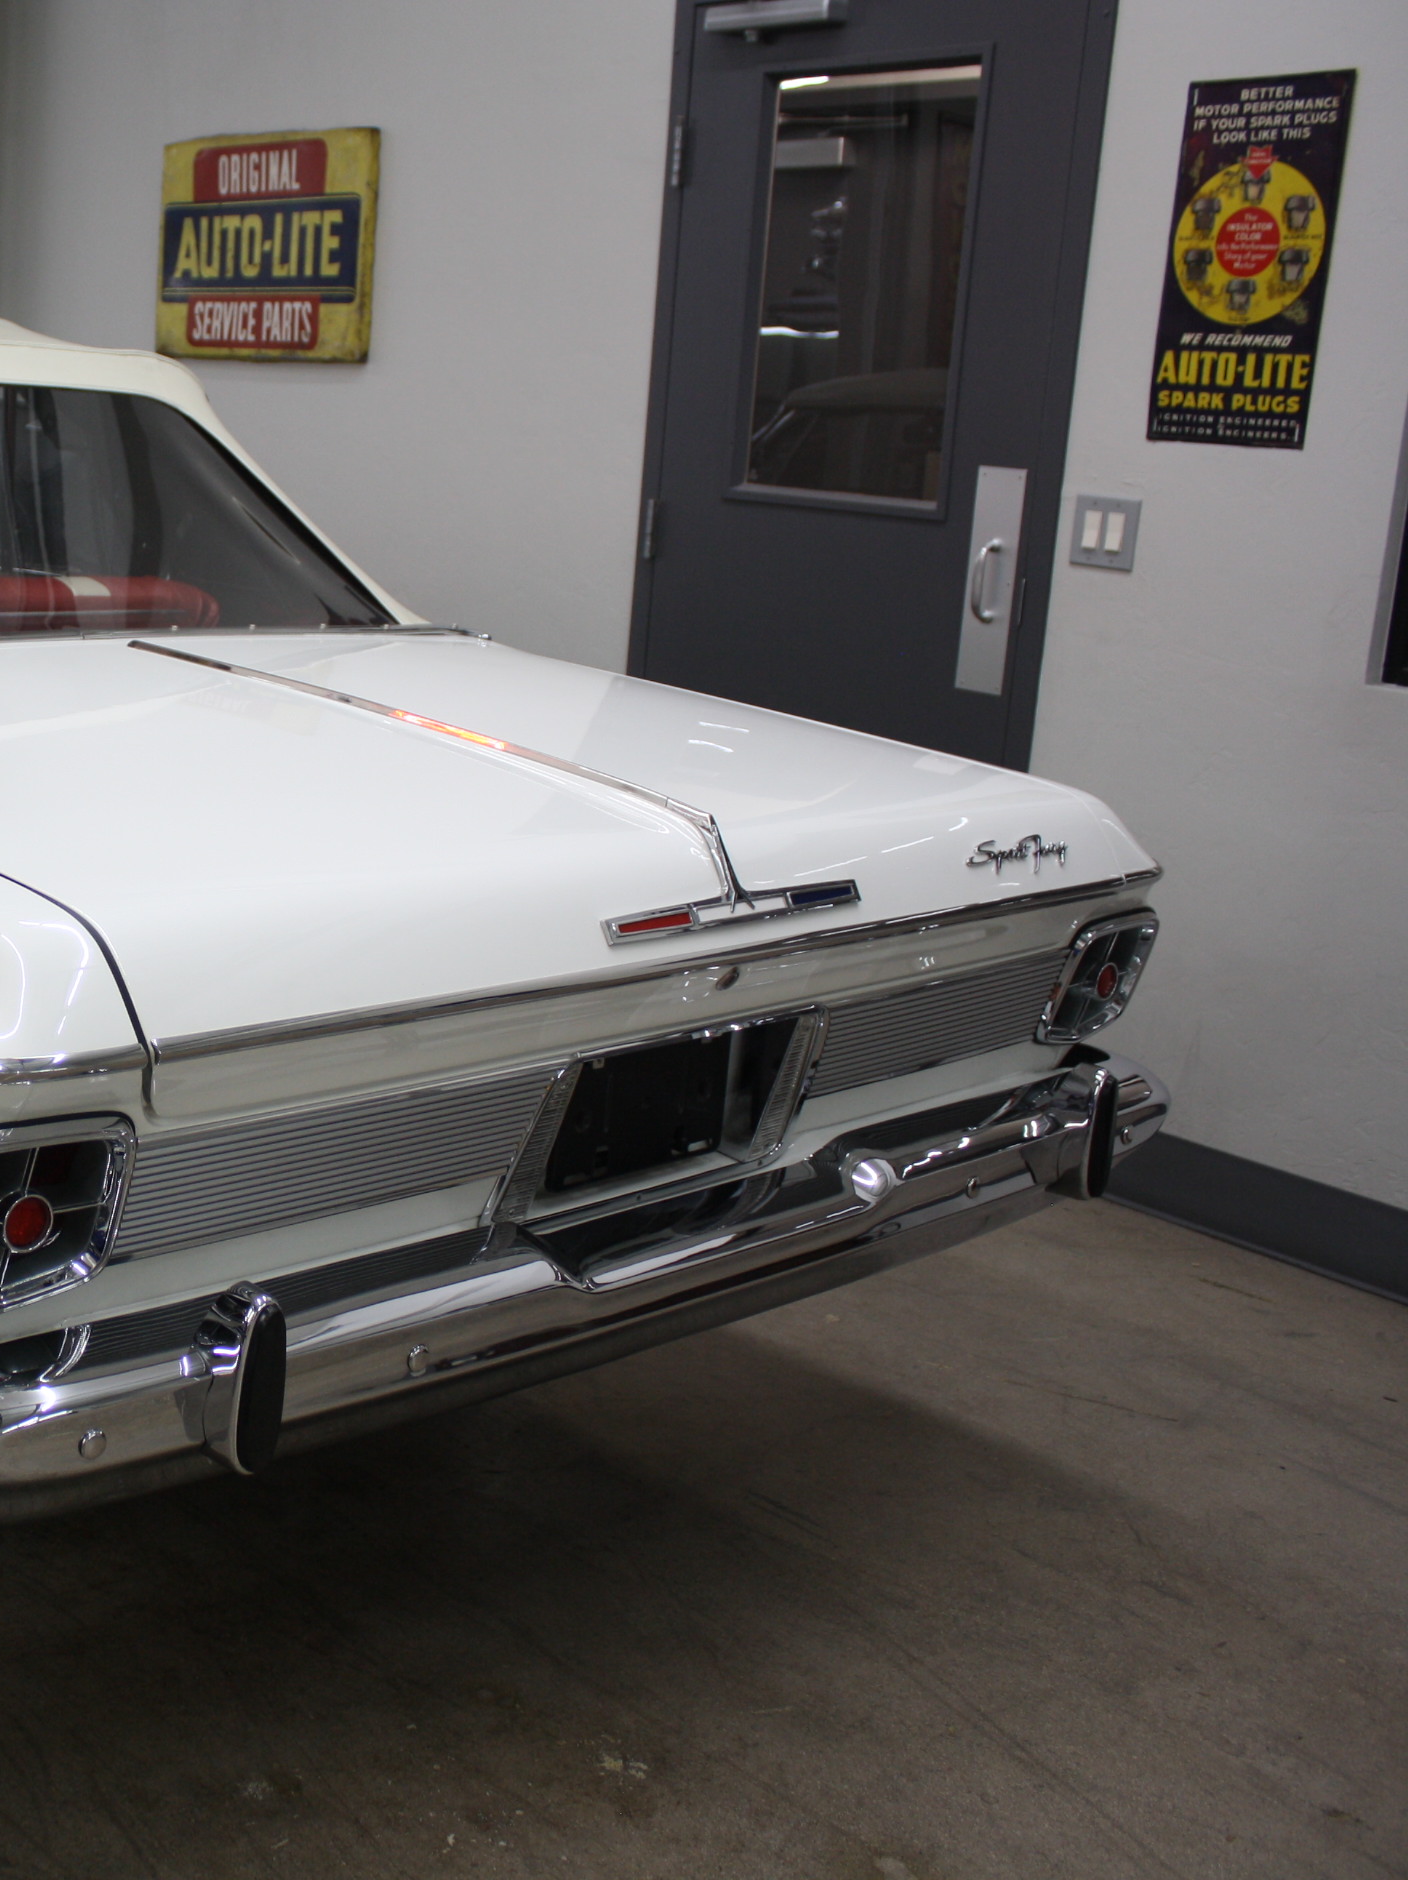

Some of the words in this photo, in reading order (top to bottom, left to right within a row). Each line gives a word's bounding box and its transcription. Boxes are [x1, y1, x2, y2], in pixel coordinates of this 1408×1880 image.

[1241, 85, 1294, 101] BETTER
[1194, 103, 1239, 118] MOTOR
[1243, 96, 1340, 114] PERFORMANCE
[1193, 119, 1207, 131] IF
[1211, 117, 1246, 130] YOUR
[1249, 115, 1291, 128] SPARK
[1294, 110, 1338, 125] PLUGS
[1212, 131, 1247, 144] LOOK
[1250, 129, 1278, 141] LIKE
[1282, 127, 1311, 139] THIS
[218, 149, 300, 195] ORIGINAL
[1227, 222, 1273, 231] INSULATOR
[173, 209, 343, 279] AUTO-LITE
[1235, 232, 1262, 241] COLOR
[193, 301, 257, 341] SERVICE
[261, 301, 312, 343] PARTS
[1180, 333, 1203, 345] WE
[1205, 333, 1293, 347] RECOMMEND
[1157, 351, 1311, 389] AUTO-LITE
[1158, 390, 1225, 410] SPARK
[1231, 393, 1301, 413] PLUGS
[1158, 425, 1213, 435] IGNITION
[1159, 413, 1214, 423] IGNITION
[1219, 415, 1298, 428] ENGINEERED
